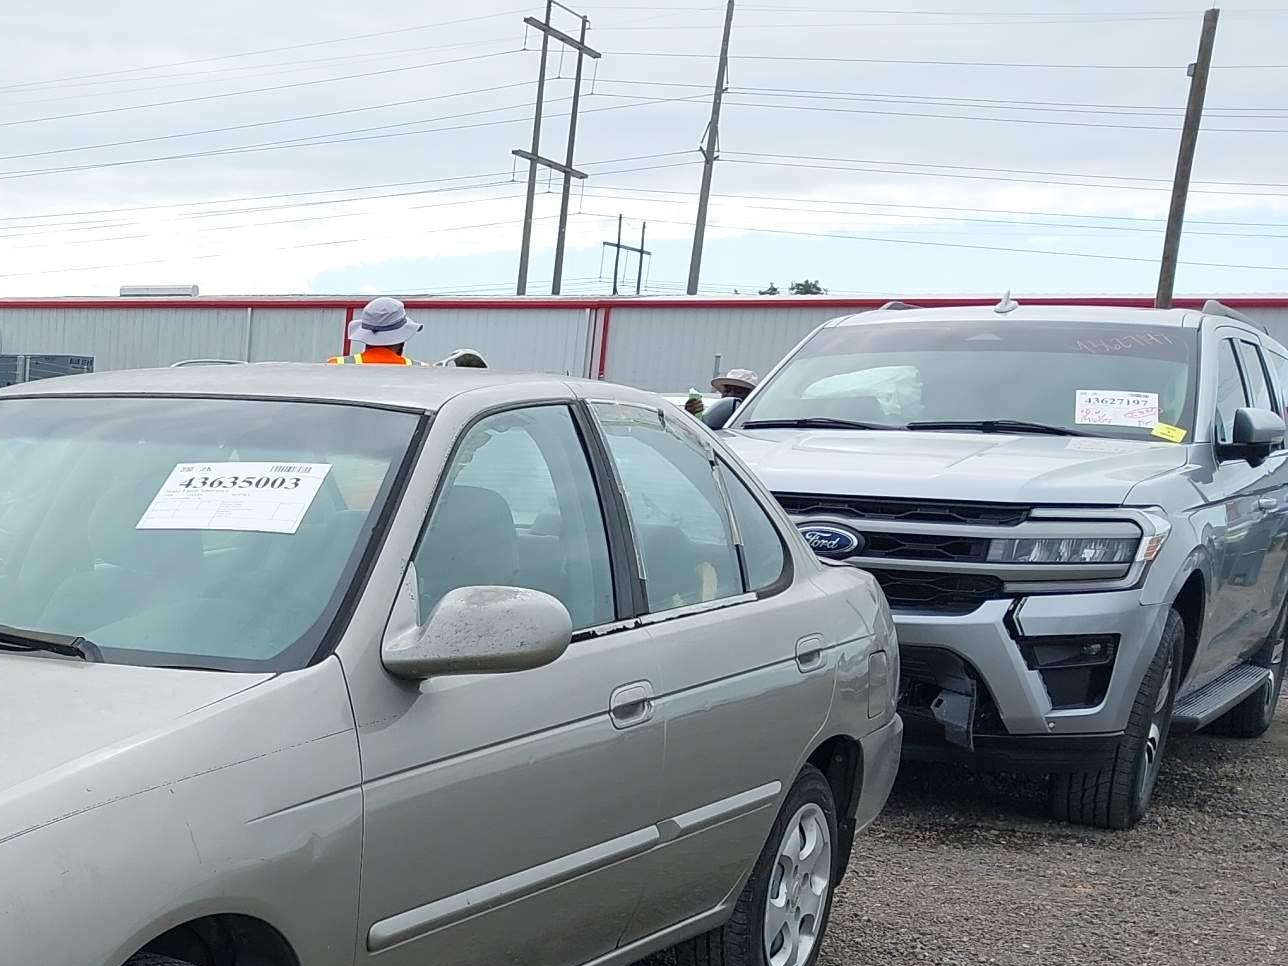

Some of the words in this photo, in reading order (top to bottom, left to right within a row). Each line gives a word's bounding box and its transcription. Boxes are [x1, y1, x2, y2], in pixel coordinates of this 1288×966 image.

[1084, 397, 1149, 407] 43627197
[179, 476, 302, 490] 43635003
[805, 531, 841, 549] Ford
